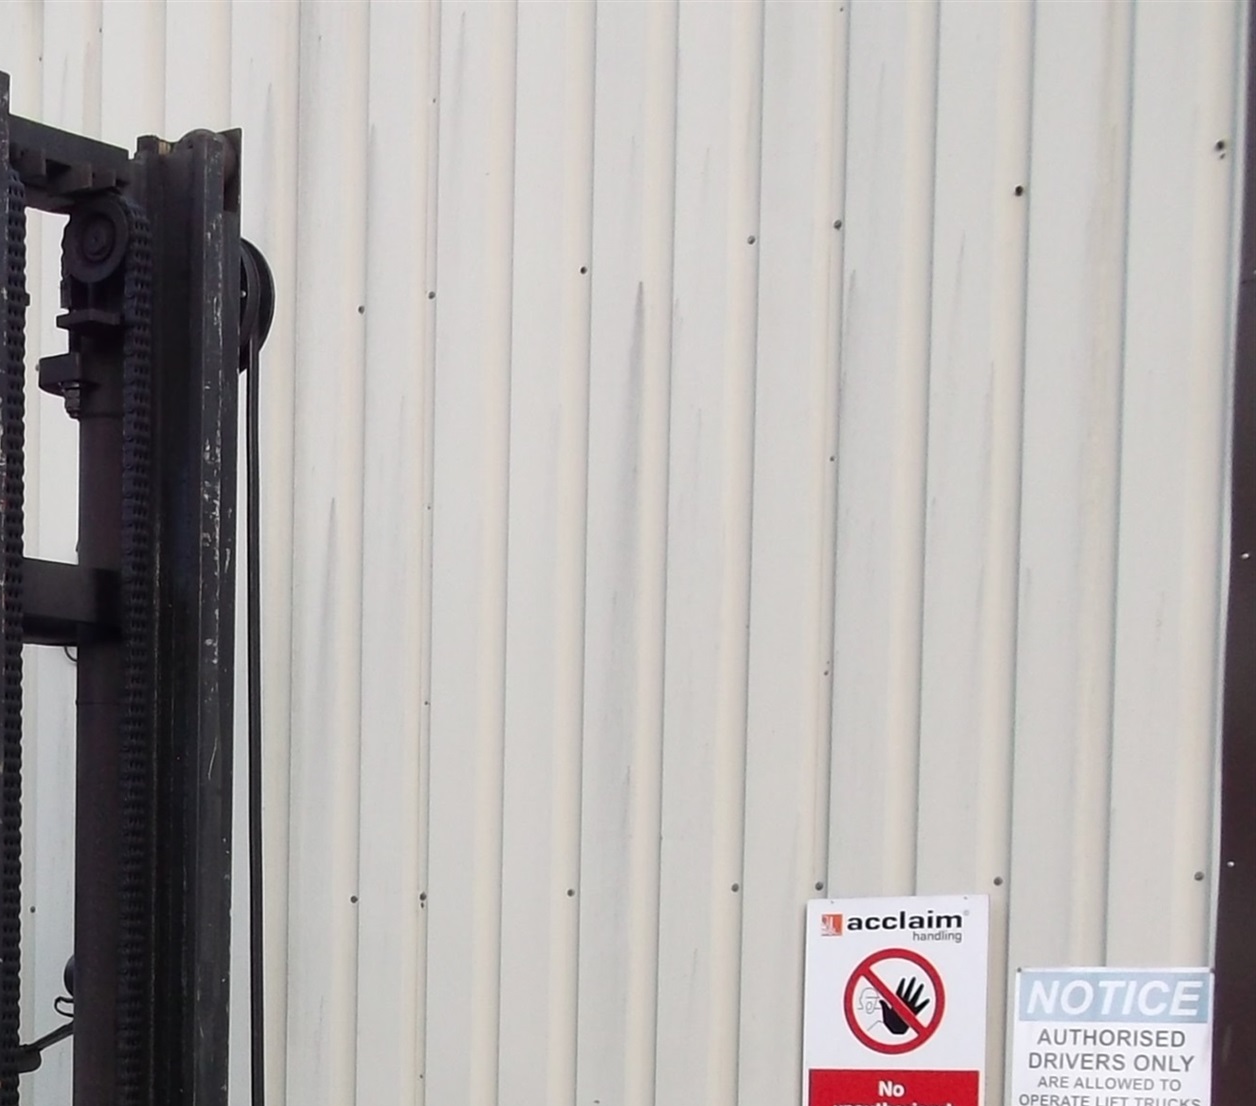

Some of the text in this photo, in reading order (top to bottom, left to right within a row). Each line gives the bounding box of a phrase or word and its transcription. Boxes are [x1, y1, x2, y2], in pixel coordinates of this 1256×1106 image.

[847, 910, 962, 930] acclaim
[912, 931, 962, 943] handling
[1026, 979, 1204, 1016] NOTICE
[1036, 1028, 1186, 1047] AUTHORISED
[1028, 1052, 1195, 1072] DRIVERS ONLY
[878, 1081, 905, 1097] No
[1037, 1076, 1182, 1092] ARE ALLOWED TO
